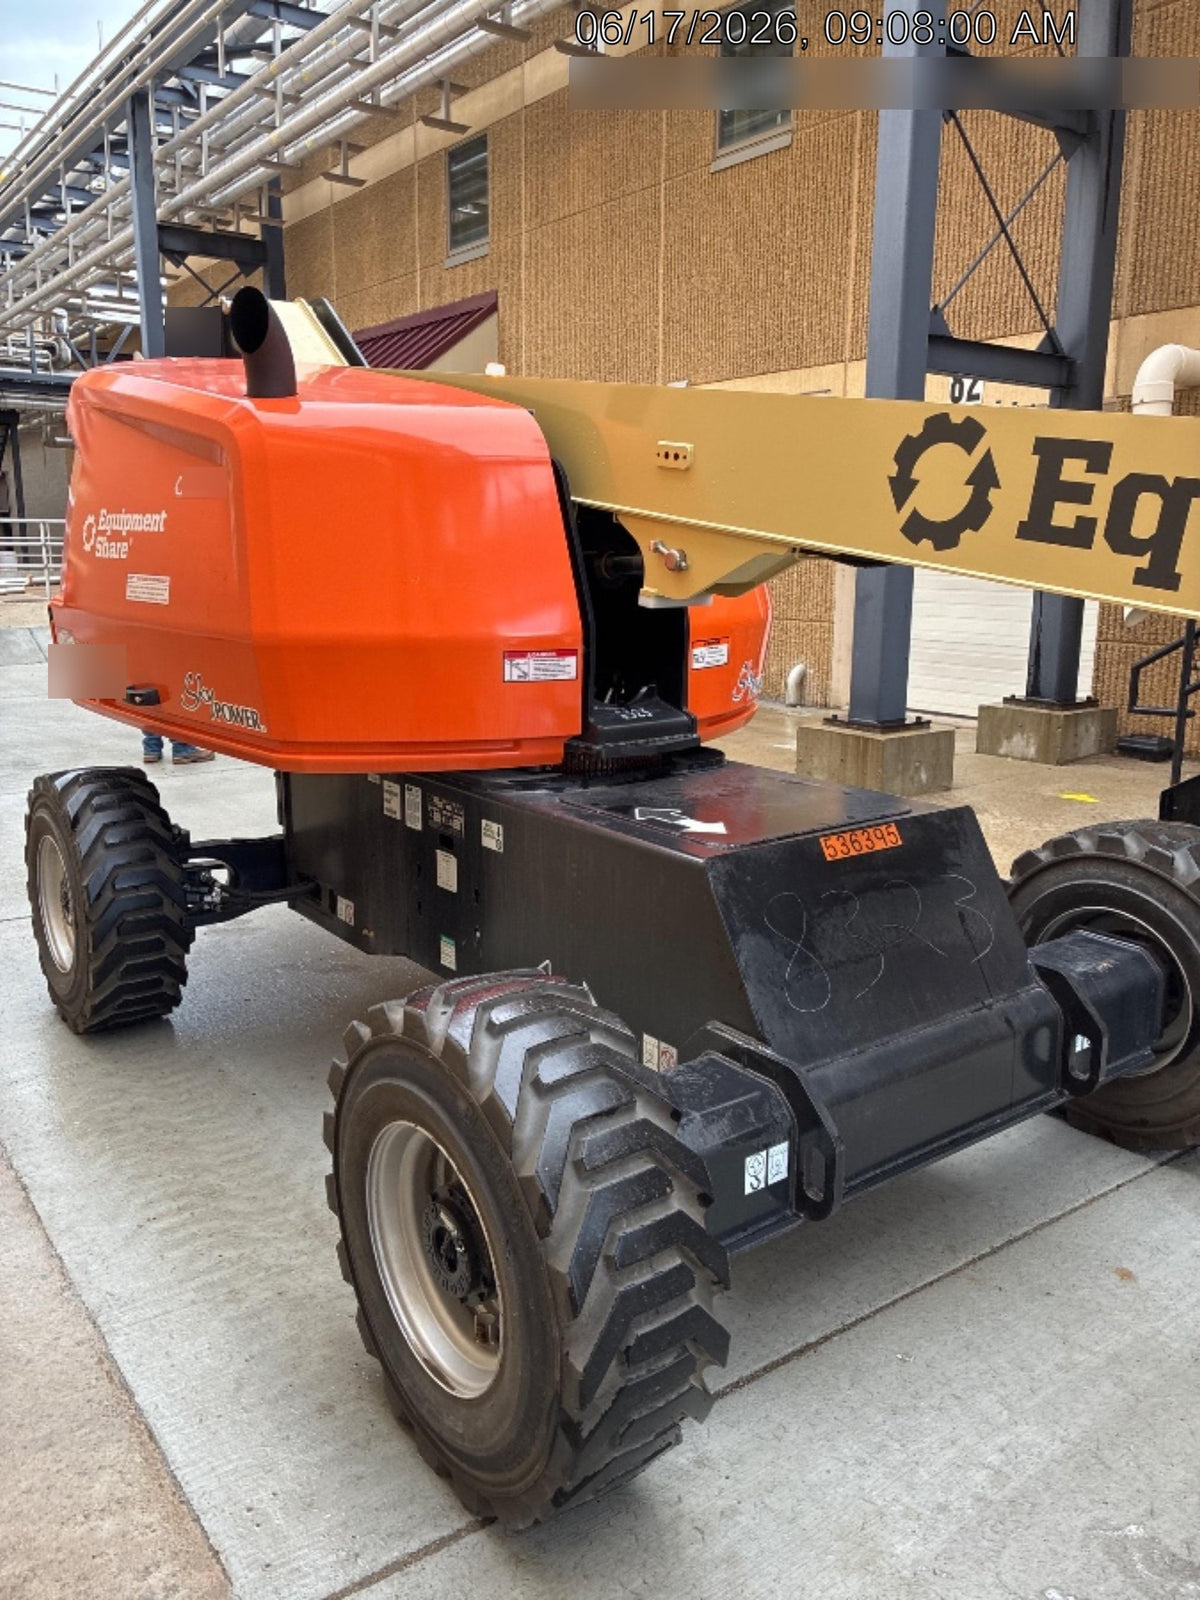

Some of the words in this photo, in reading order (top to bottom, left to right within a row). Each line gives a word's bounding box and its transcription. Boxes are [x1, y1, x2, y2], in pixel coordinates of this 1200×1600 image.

[98, 508, 168, 536] Equipment
[1015, 436, 1200, 592] Eq
[95, 536, 129, 559] Share
[823, 824, 899, 858] 536395
